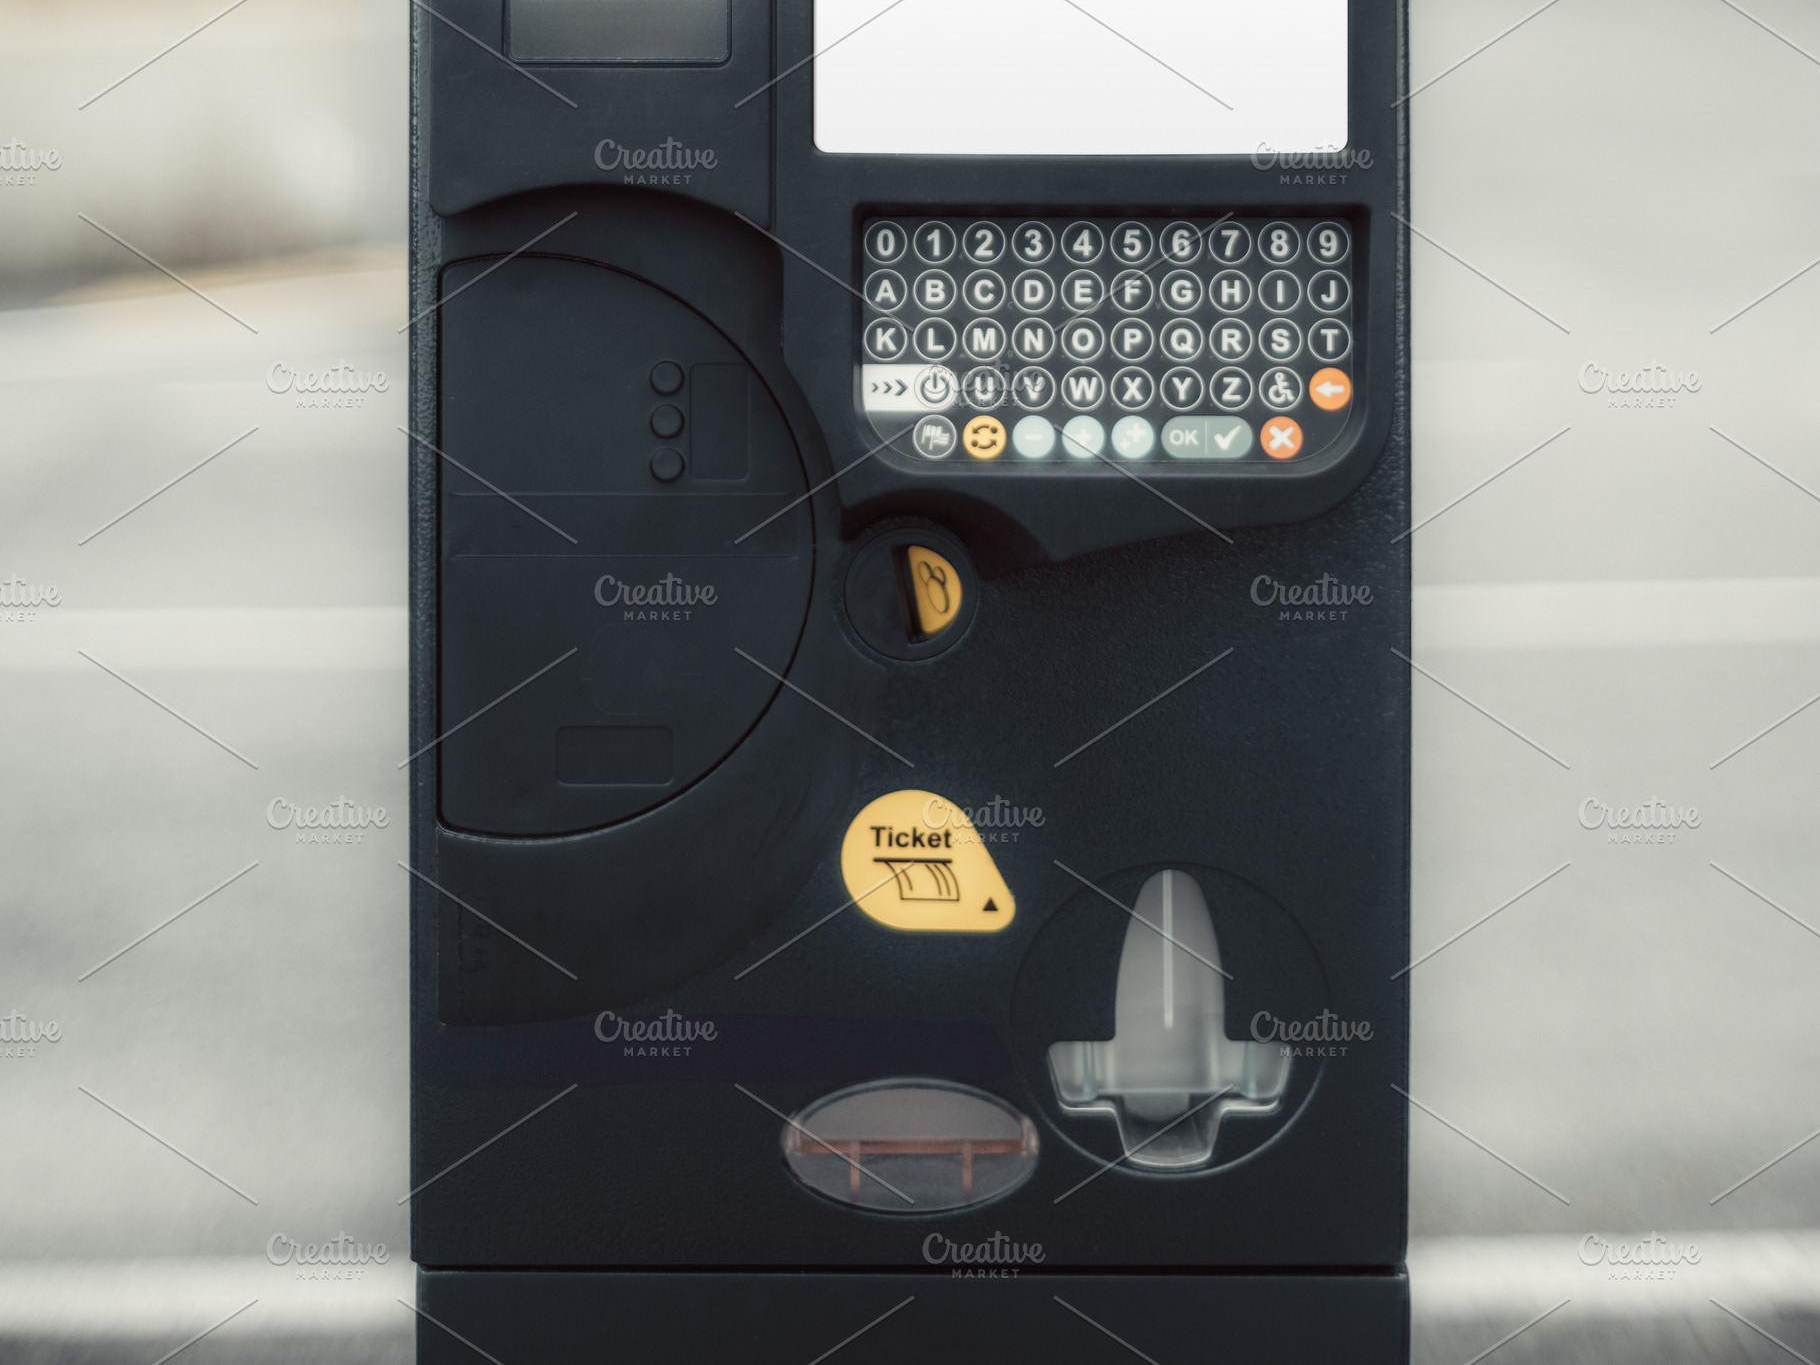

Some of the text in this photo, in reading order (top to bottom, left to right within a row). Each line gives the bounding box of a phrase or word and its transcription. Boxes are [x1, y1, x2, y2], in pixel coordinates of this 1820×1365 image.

[877, 229, 1337, 257] 0 1 2 3 4 5 6 7 8 9
[874, 279, 1336, 304] A B C D E F G H I J
[876, 327, 1339, 354] K L M N O P Q R S T
[1068, 376, 1099, 402] W
[1122, 376, 1144, 402] X
[1171, 376, 1193, 402] Y
[1221, 377, 1242, 402] Z
[1168, 428, 1199, 446] OK
[870, 826, 952, 848] Ticket
